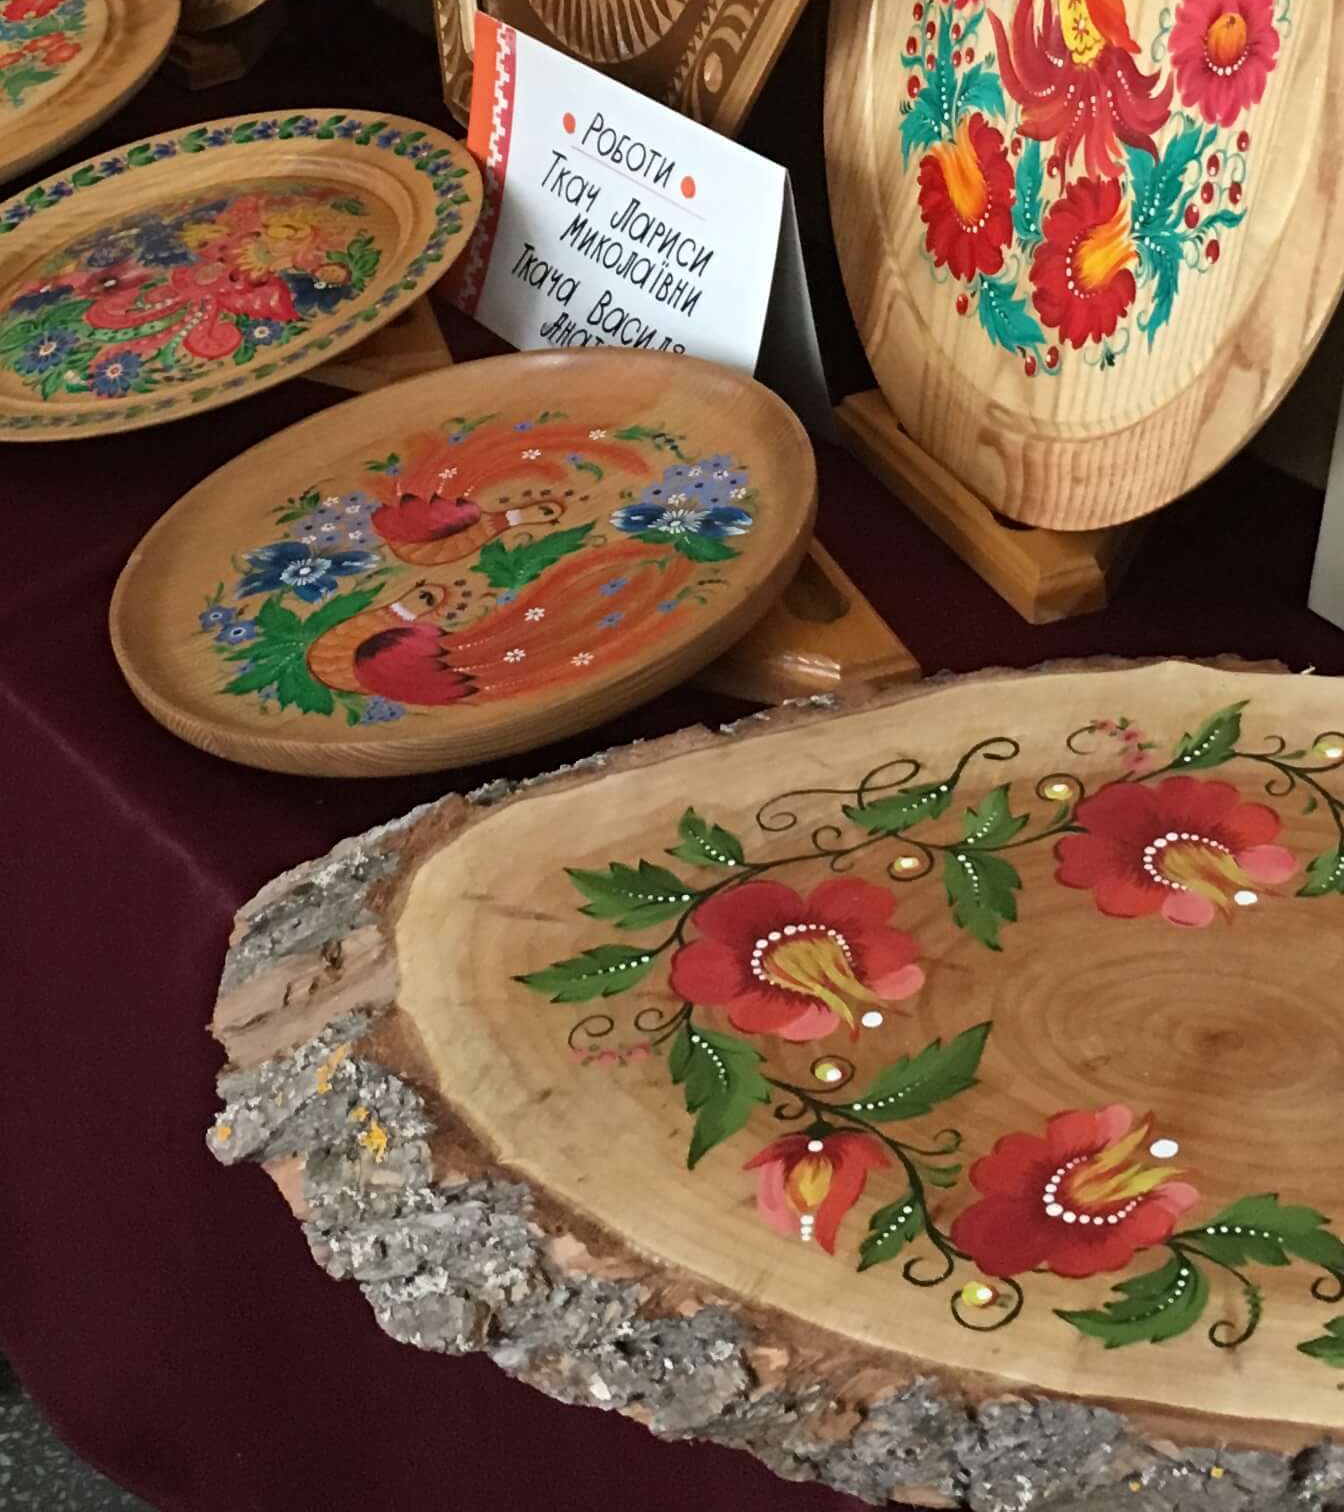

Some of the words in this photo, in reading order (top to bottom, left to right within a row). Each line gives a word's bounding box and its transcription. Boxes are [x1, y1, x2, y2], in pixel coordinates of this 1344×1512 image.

[581, 112, 676, 189] РОБОТИ
[541, 149, 602, 213] Ткач
[610, 197, 714, 277] Лариси
[511, 242, 582, 306] Ткача
[559, 213, 703, 317] Миколаївни
